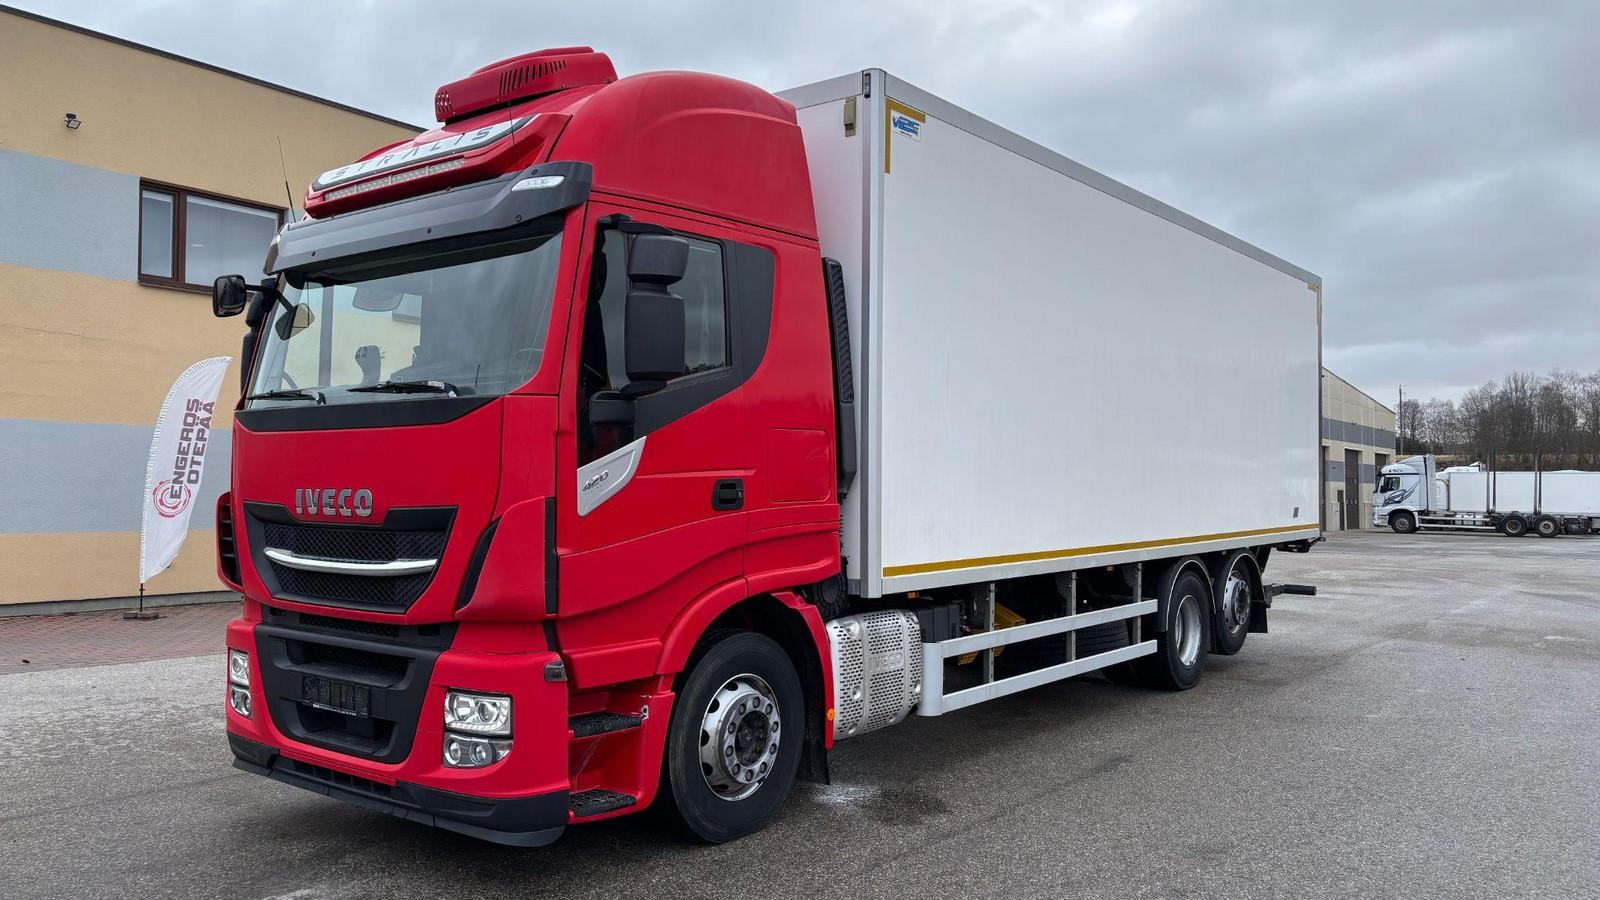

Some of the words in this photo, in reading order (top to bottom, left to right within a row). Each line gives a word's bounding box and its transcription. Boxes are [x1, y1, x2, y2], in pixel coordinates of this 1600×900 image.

[332, 126, 492, 180] STRALIS
[169, 398, 200, 500] ENGEROS
[186, 401, 216, 485] OTEPÄÄ
[295, 488, 373, 517] IVECO
[582, 469, 609, 491] 420
